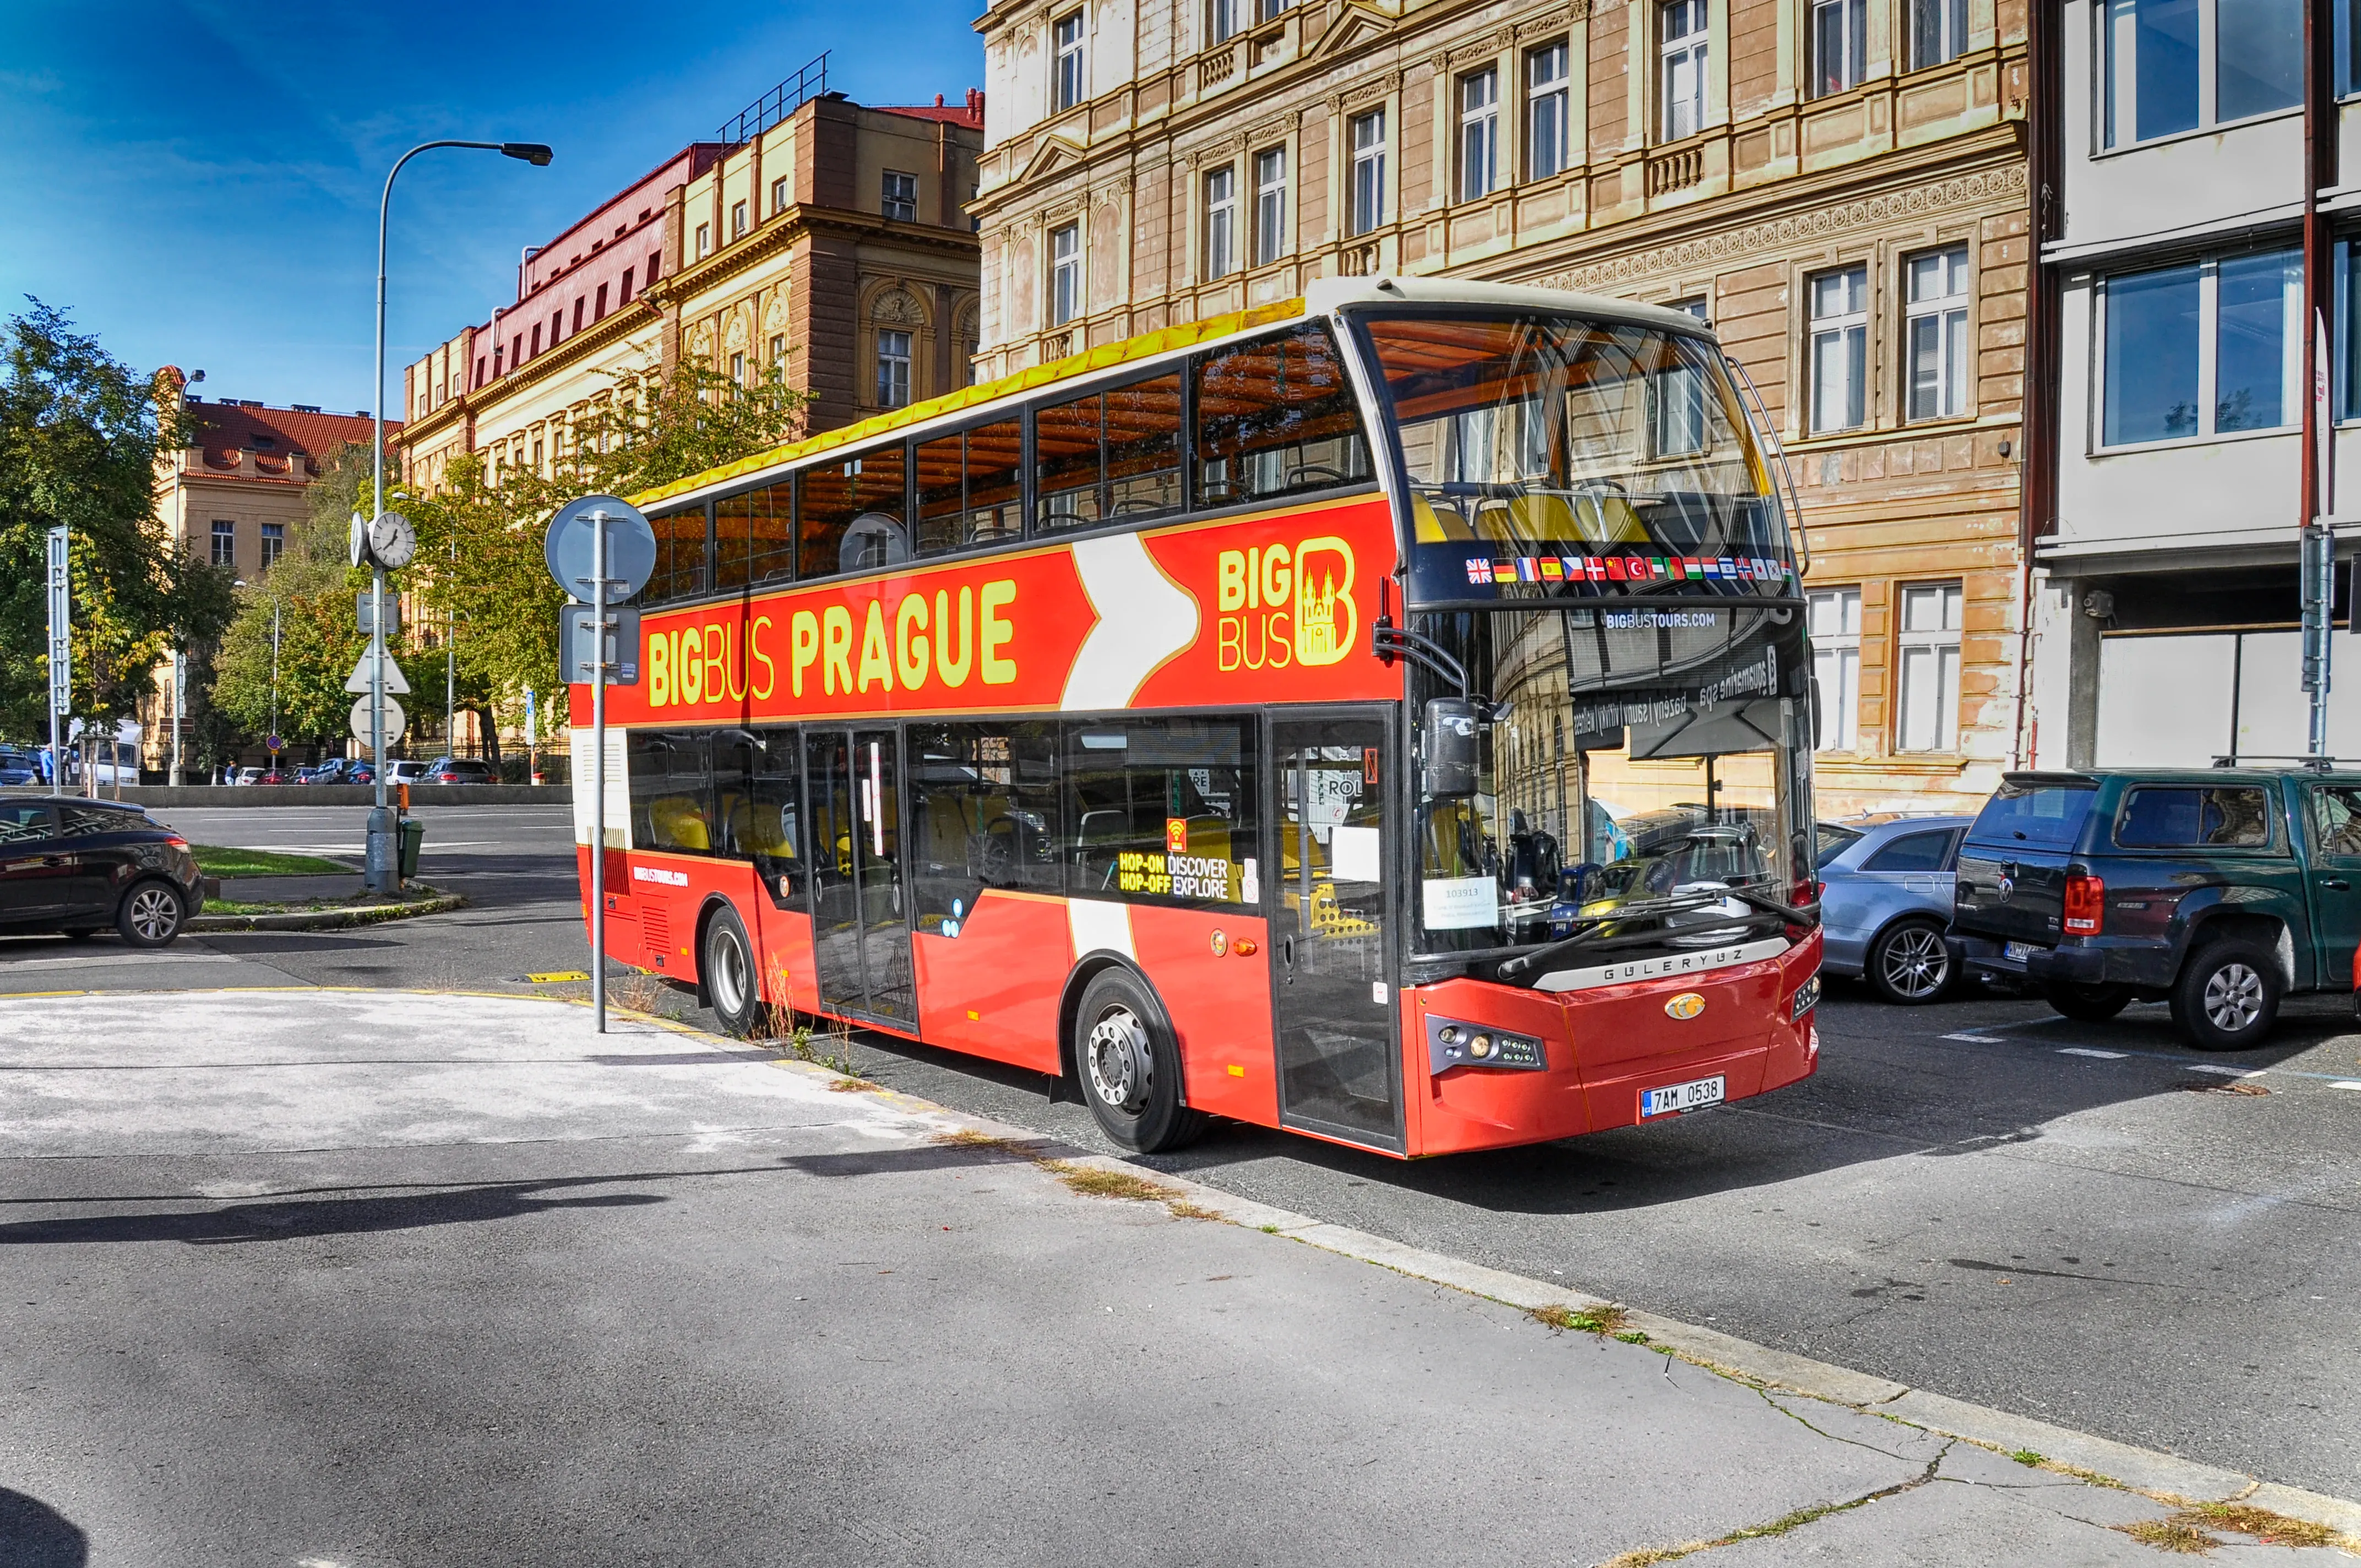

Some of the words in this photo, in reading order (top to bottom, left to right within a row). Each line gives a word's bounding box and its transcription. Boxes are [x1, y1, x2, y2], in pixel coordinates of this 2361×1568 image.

[1218, 543, 1292, 612] BIG
[1606, 612, 1716, 629] BIGBUSTOURS.COM
[649, 616, 775, 708] BIGBUS
[791, 578, 1018, 699] PRAGUE
[1218, 611, 1292, 672] BUS
[1119, 853, 1165, 874] HOP-ON
[1167, 856, 1228, 879] DISCOVER
[1120, 872, 1172, 894] HOP-OFF
[1173, 876, 1228, 900] EXPLORE
[1446, 888, 1478, 899] 103913
[1655, 1088, 1678, 1111] 7AM
[1688, 1081, 1718, 1103] 0538
